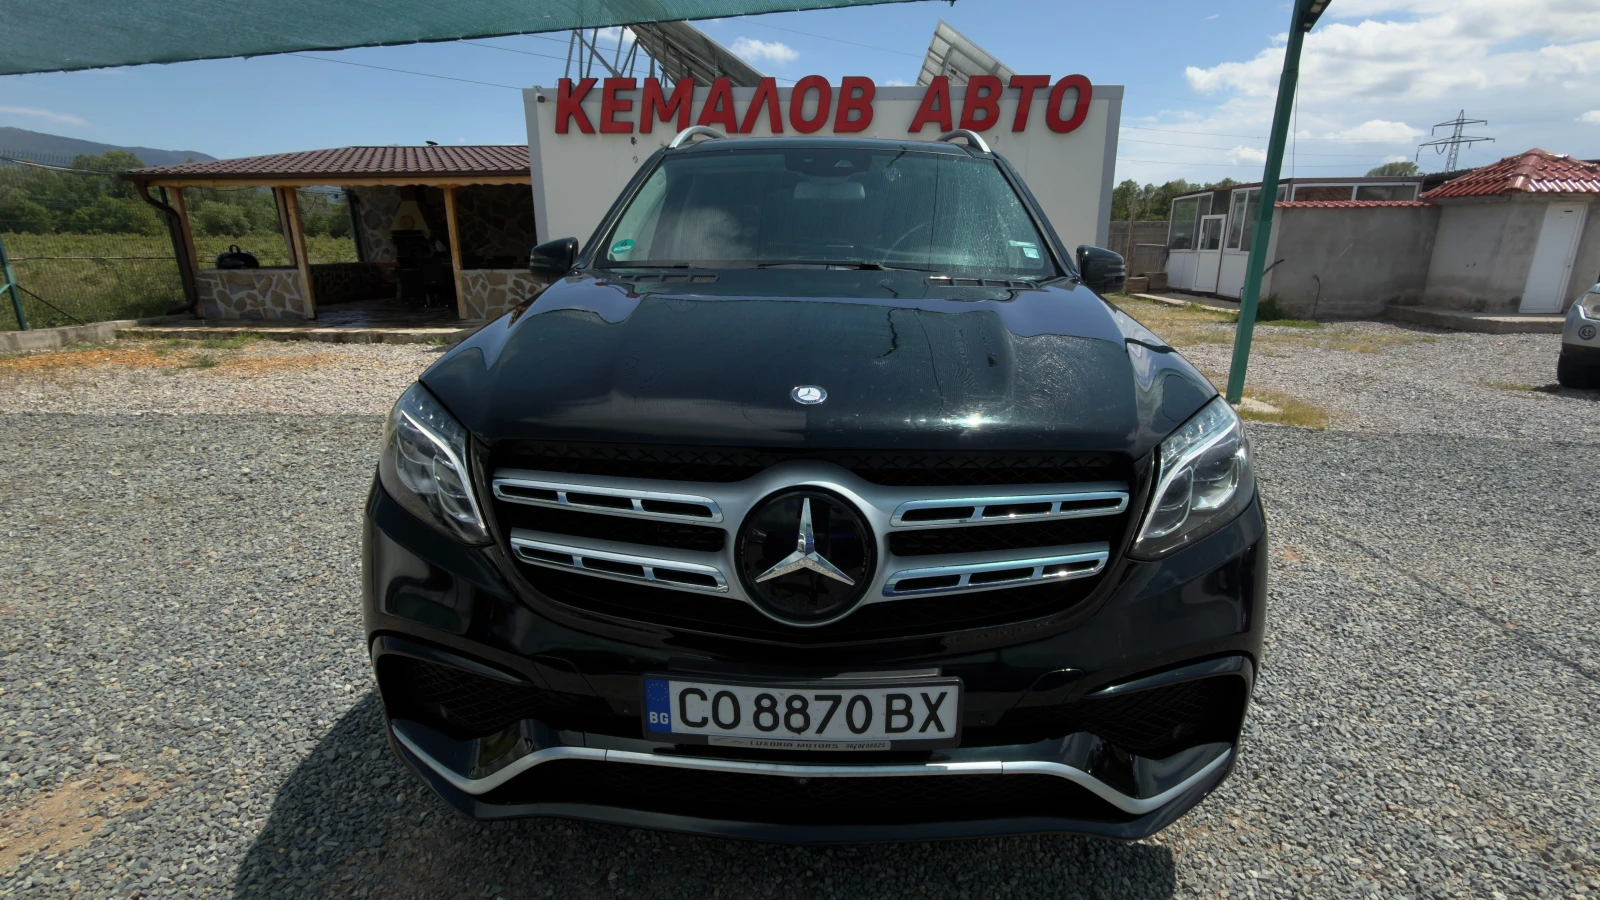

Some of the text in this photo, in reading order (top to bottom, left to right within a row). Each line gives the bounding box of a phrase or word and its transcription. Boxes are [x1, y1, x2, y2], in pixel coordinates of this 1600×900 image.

[555, 74, 1092, 133] КЕМАЛОВ АВТО
[649, 711, 669, 725] BG
[679, 687, 948, 735] CO 8870 BX
